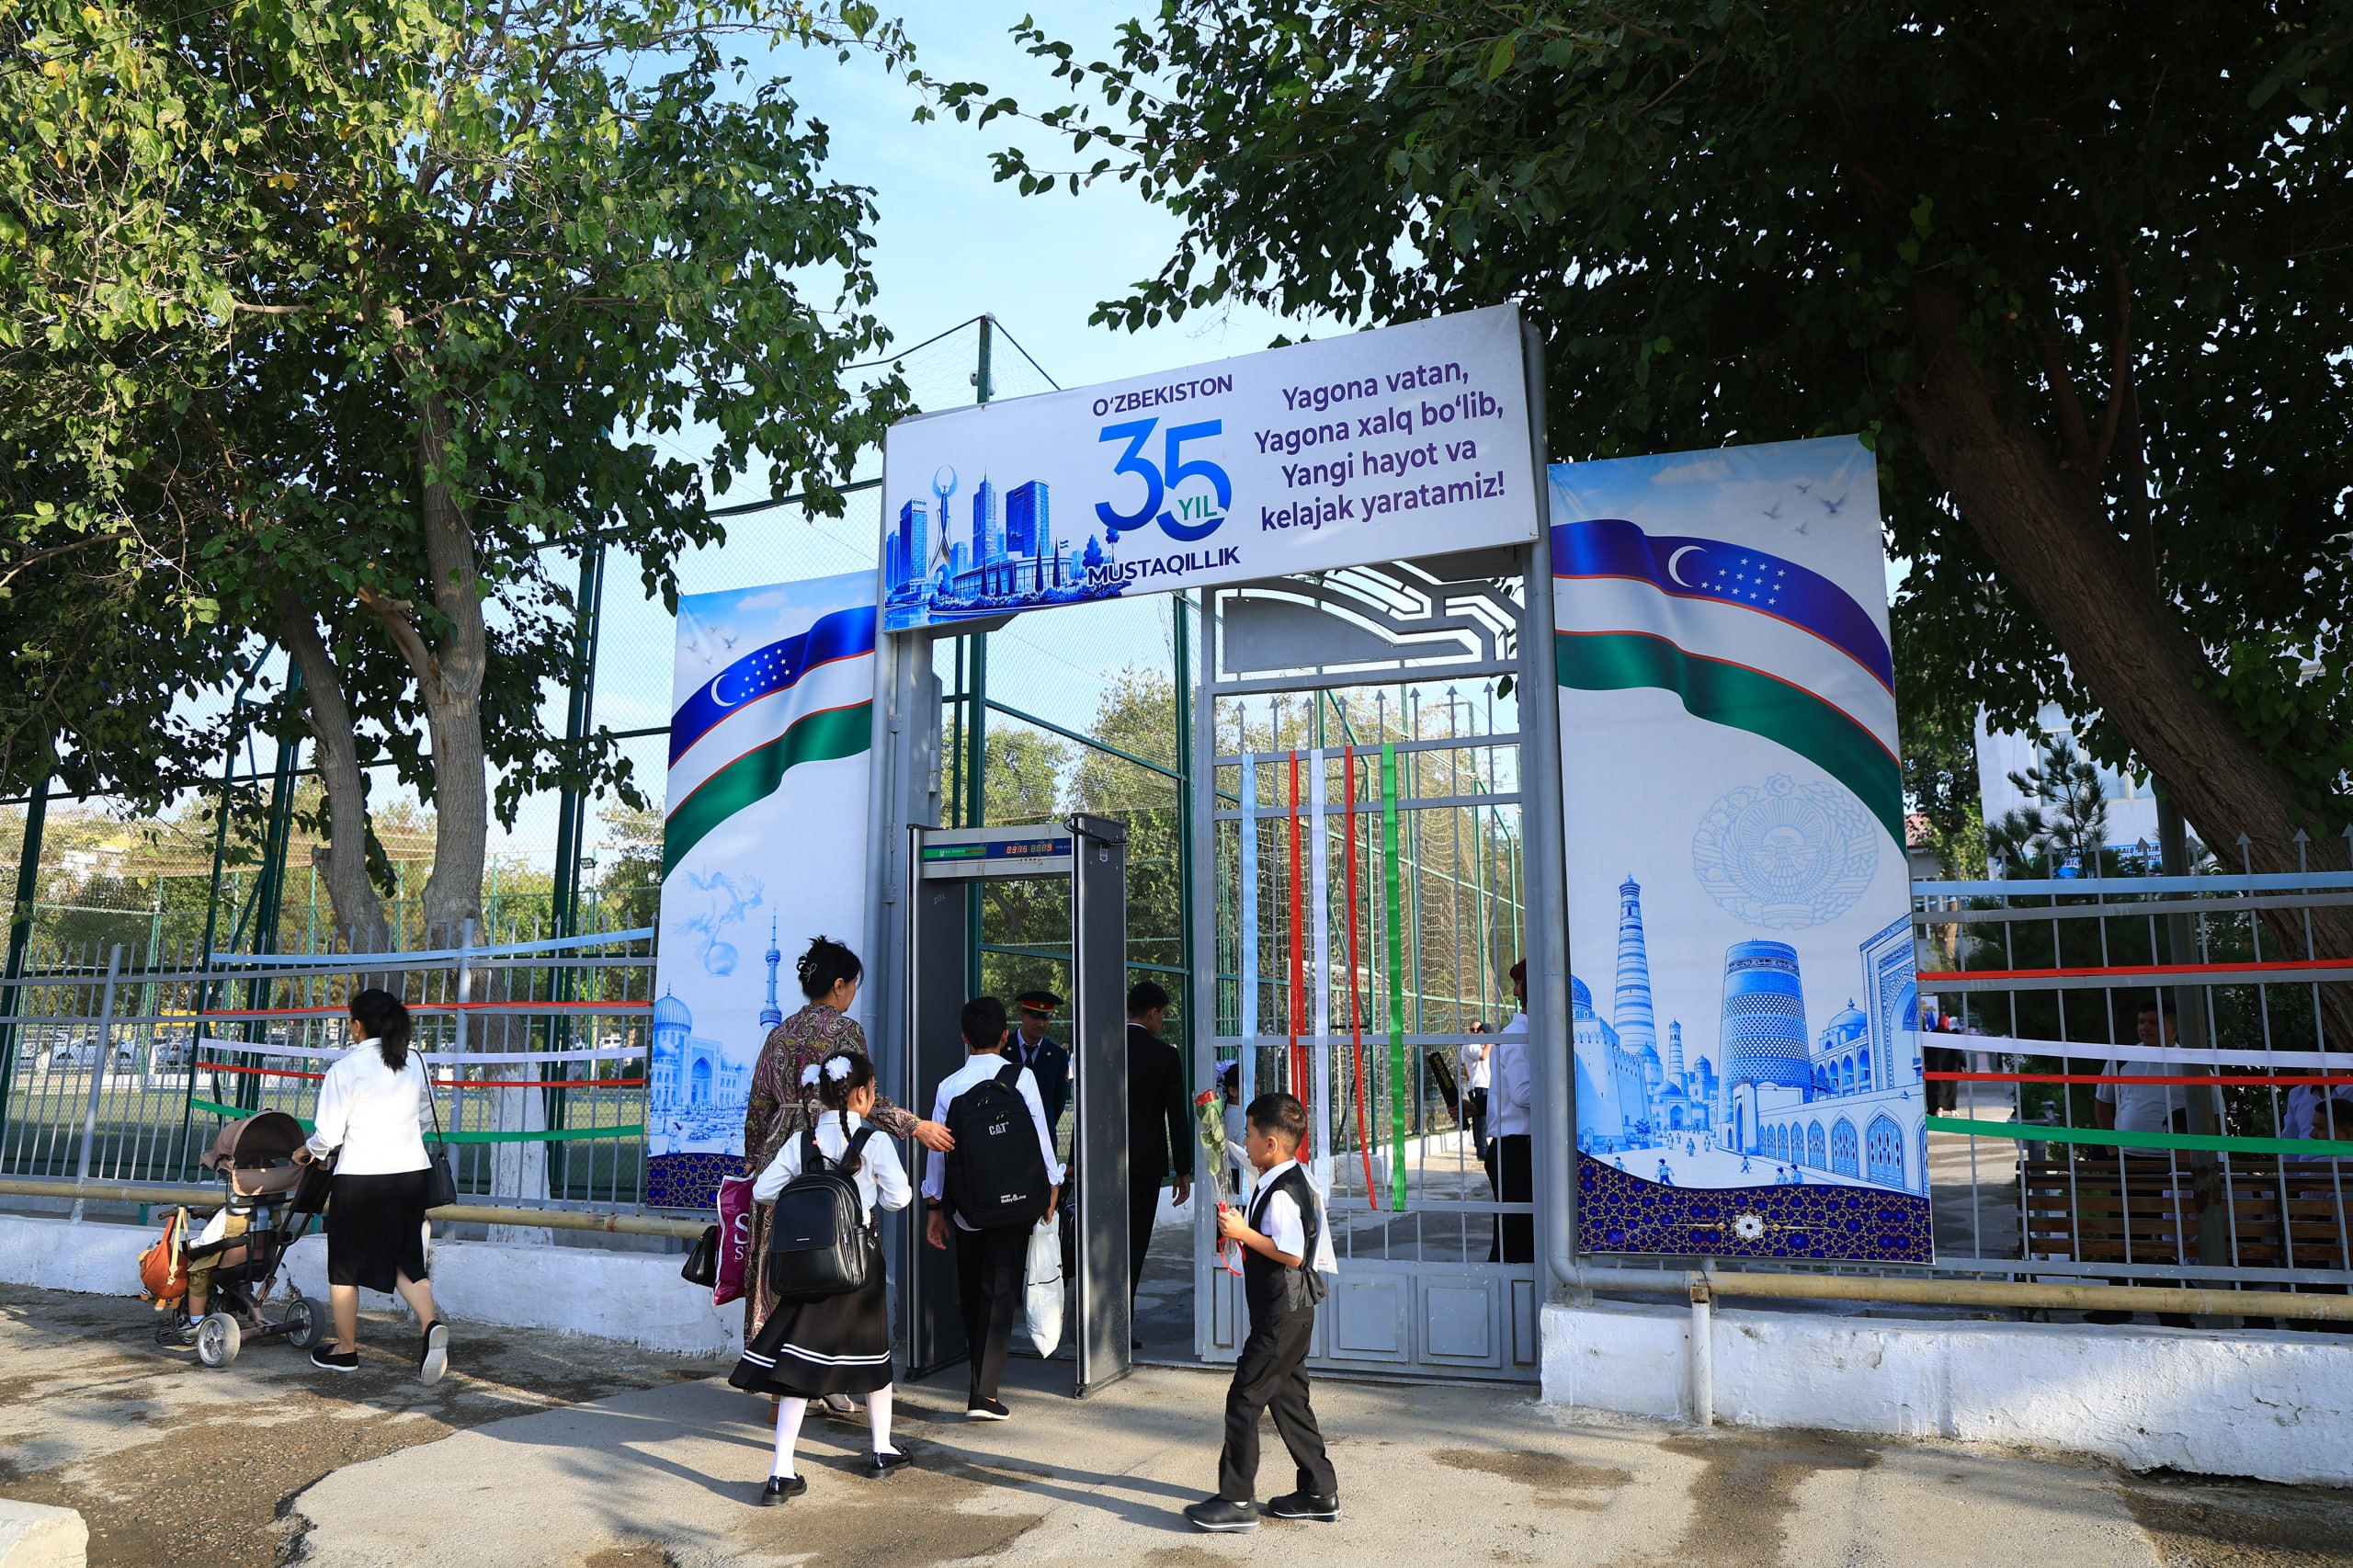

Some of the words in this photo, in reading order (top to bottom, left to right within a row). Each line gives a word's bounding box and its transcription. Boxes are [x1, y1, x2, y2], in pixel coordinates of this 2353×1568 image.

[1093, 374, 1233, 416] O‘ZBEKISTON
[1282, 377, 1378, 412] Yagona
[1385, 362, 1469, 392] vatan,
[1255, 421, 1349, 455] Yagona
[1358, 407, 1412, 436] xalq
[1421, 391, 1504, 426] bo‘lib,
[1095, 417, 1232, 541] 35
[1177, 495, 1217, 521] YIL
[1281, 452, 1353, 488] Yangi
[1363, 442, 1438, 477] hayot
[1445, 439, 1476, 461] va
[1261, 494, 1355, 531] kelajak
[1361, 471, 1506, 523] yaratamiz!
[1087, 546, 1241, 585] MUSTAQILLIK
[988, 1122, 1006, 1135] CAT
